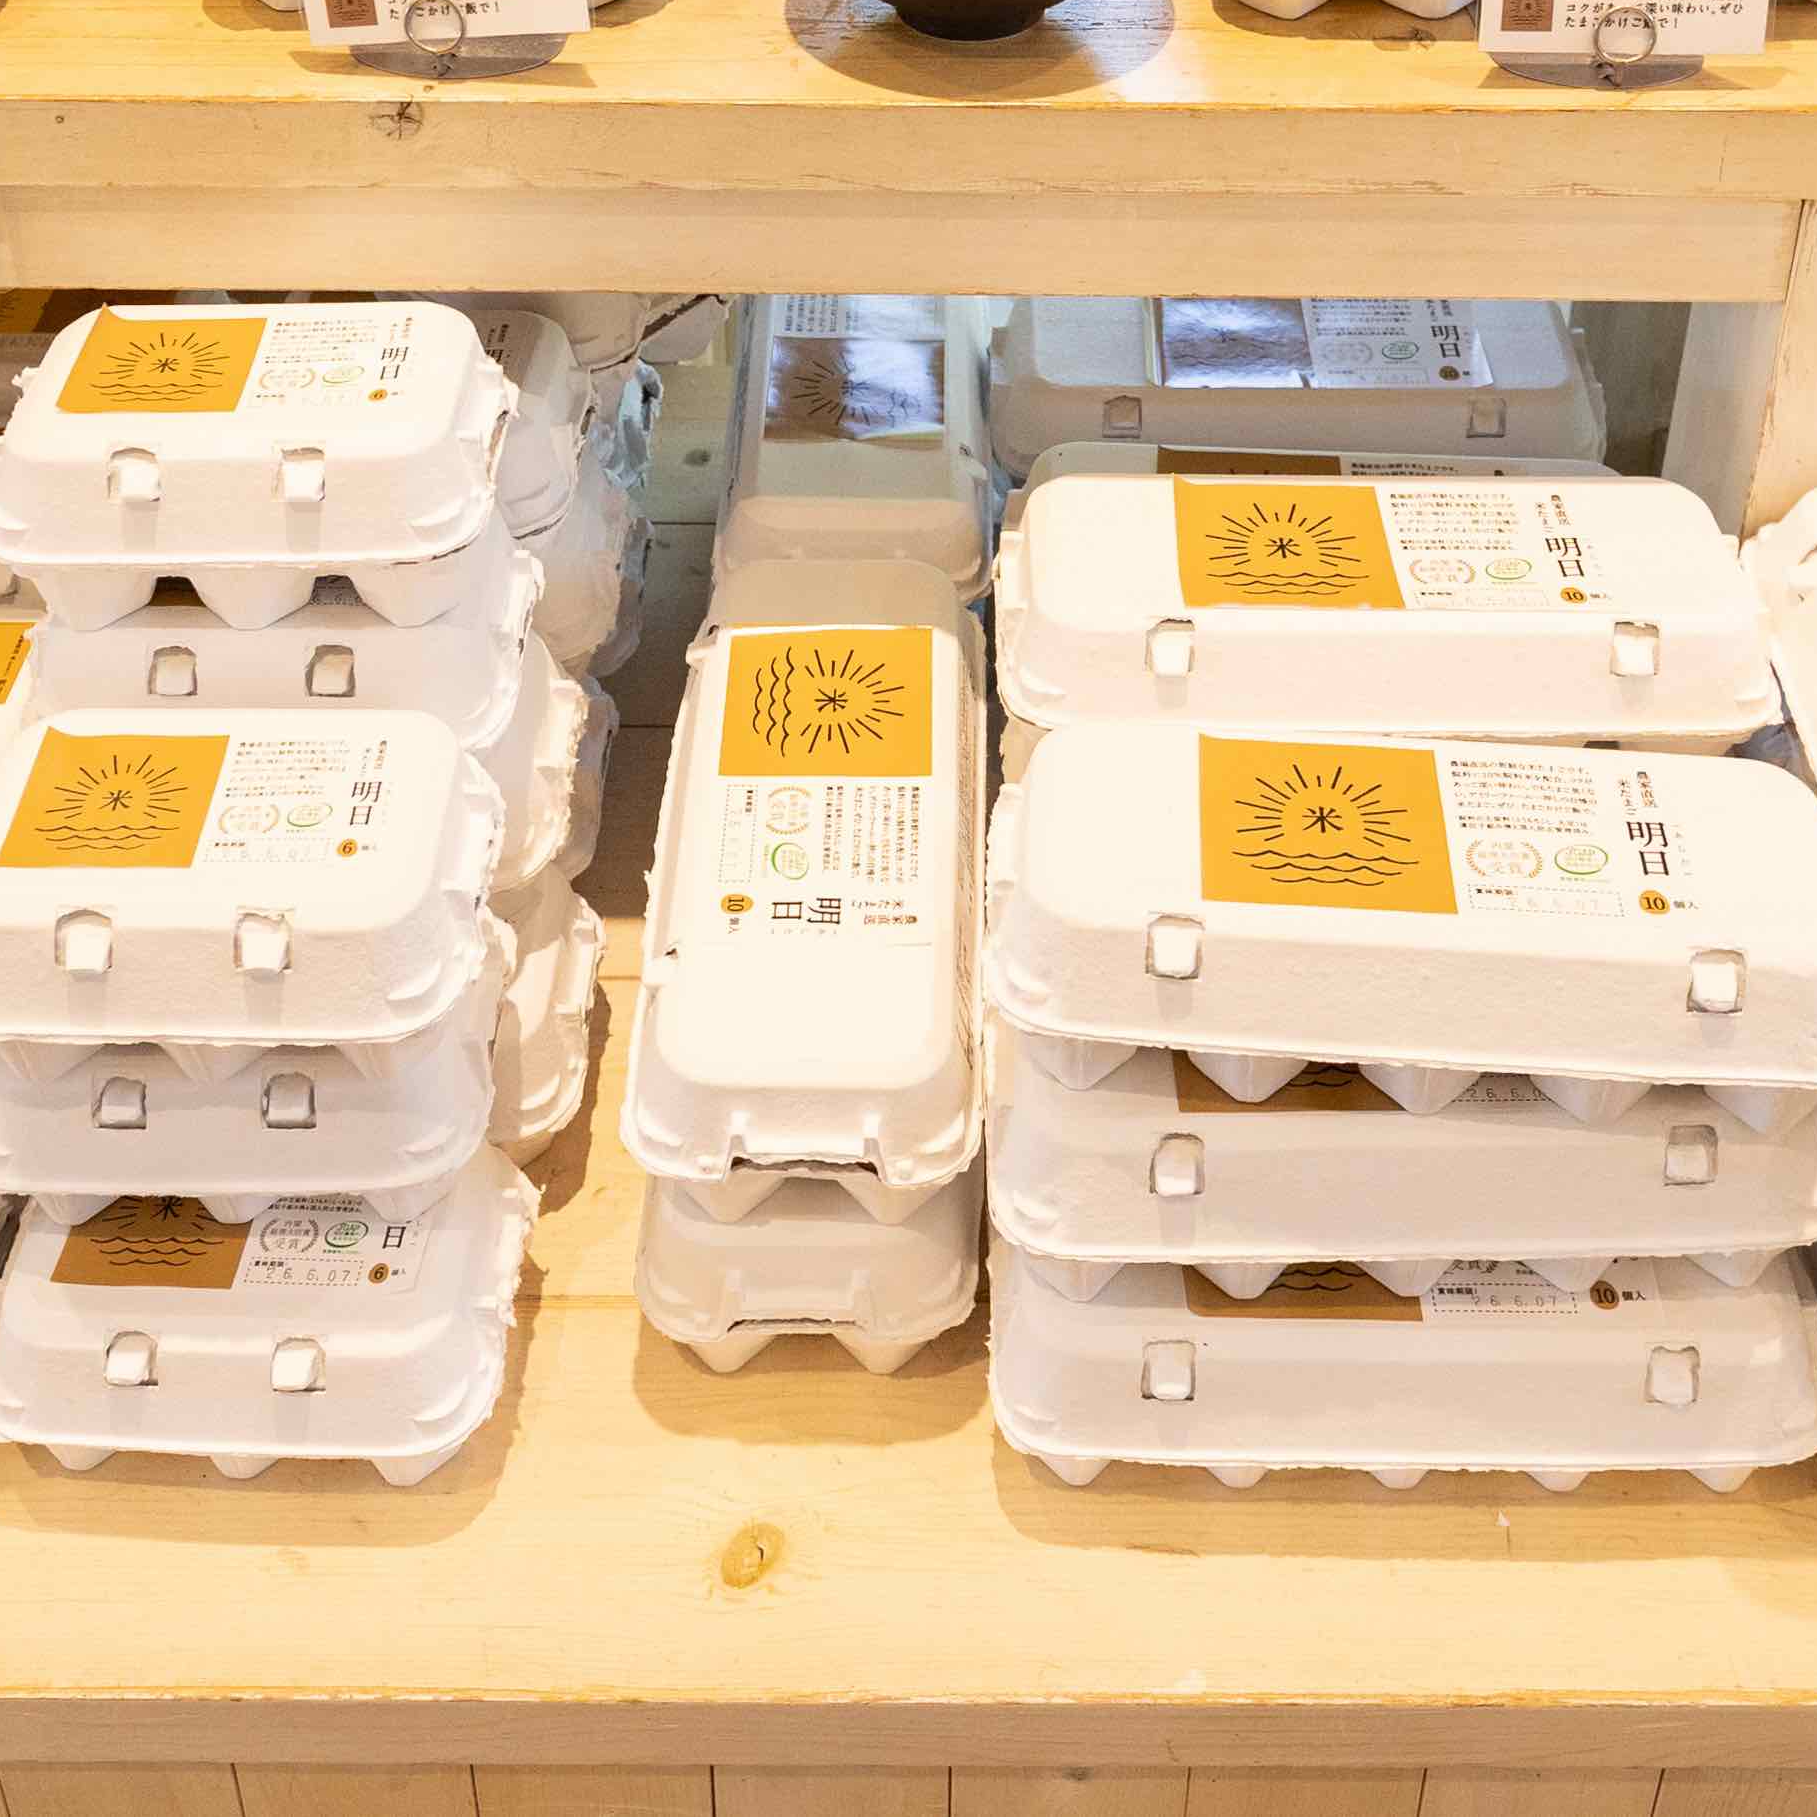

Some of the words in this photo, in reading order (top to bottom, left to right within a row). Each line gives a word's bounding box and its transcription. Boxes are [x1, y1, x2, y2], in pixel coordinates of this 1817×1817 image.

[1429, 324, 1462, 360] 明日
[150, 356, 180, 375] 米
[378, 344, 410, 382] 明日
[1264, 536, 1303, 560] 米
[1544, 537, 1585, 578] 明日
[99, 788, 134, 812] 米
[347, 779, 382, 828] 明日
[1301, 804, 1344, 834] 米
[1626, 821, 1671, 877] 明日
[770, 897, 843, 925] 明日
[1642, 895, 1667, 911] 10
